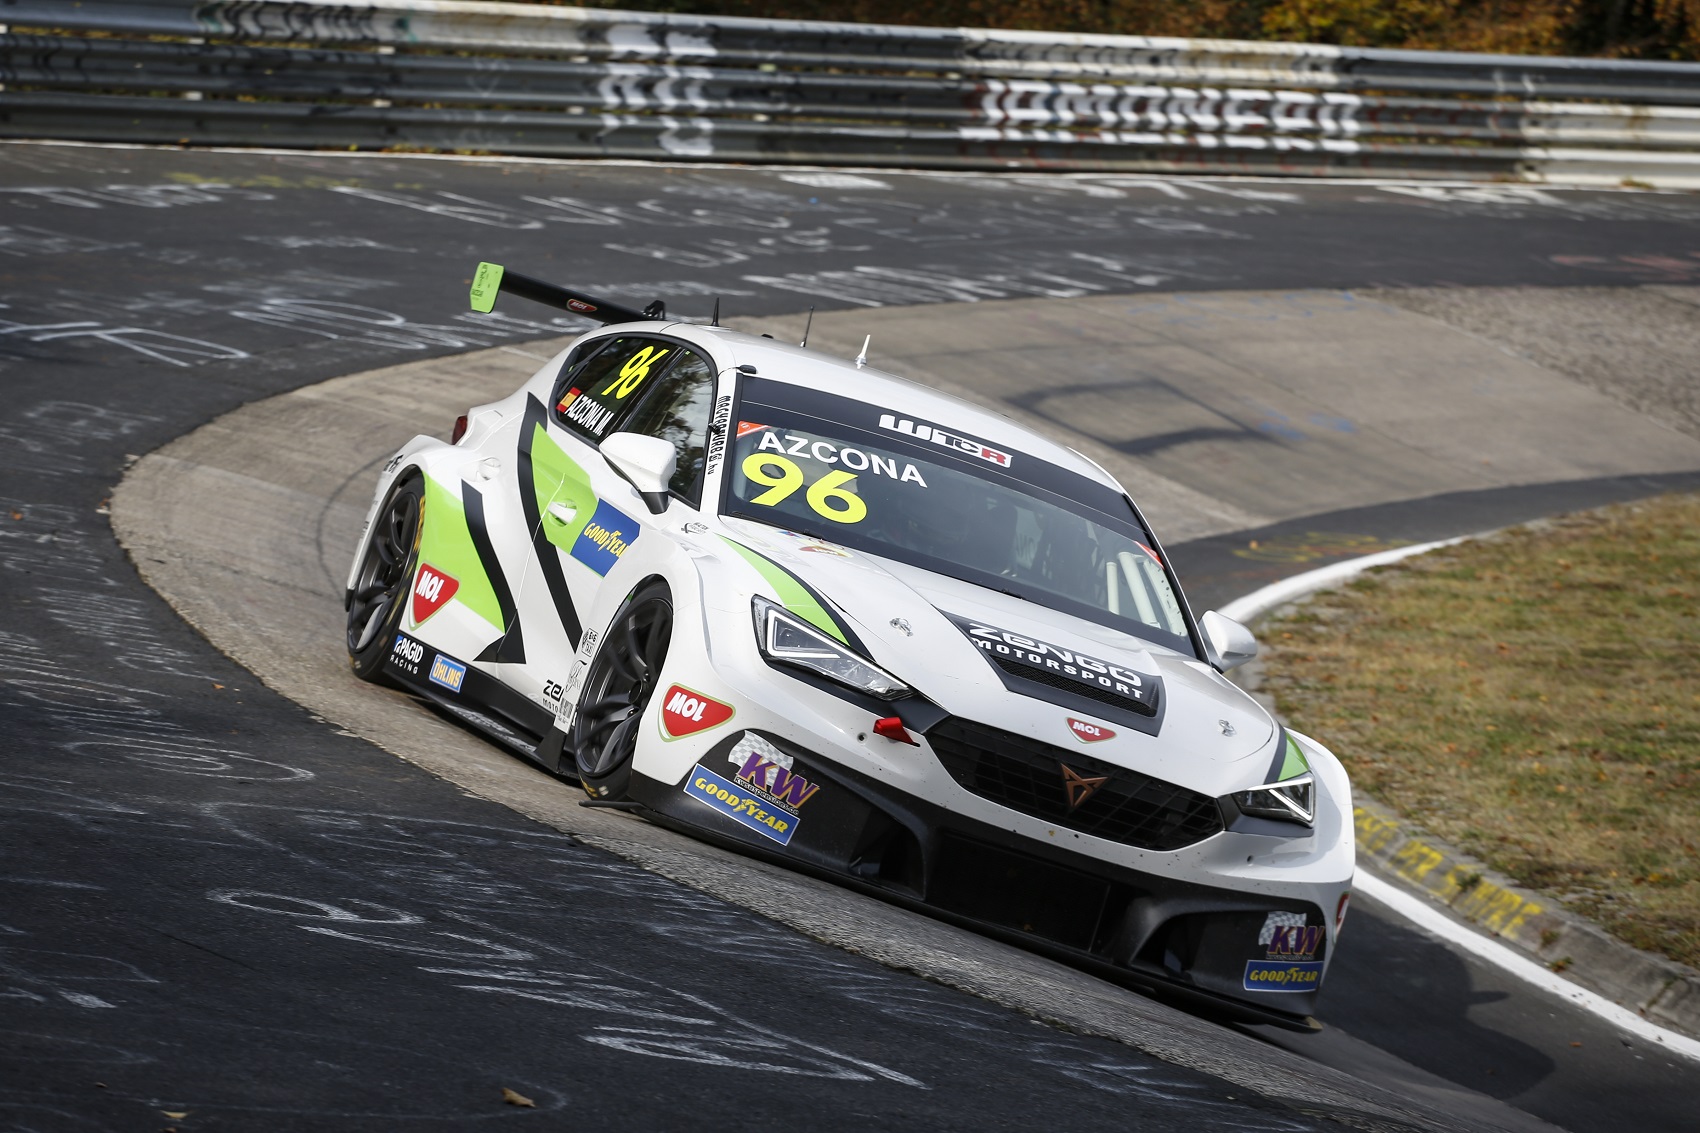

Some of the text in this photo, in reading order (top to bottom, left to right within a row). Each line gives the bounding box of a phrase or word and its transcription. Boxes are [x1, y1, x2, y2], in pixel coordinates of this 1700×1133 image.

[570, 301, 588, 310] MOL
[601, 346, 670, 399] 96
[564, 394, 606, 431] AZCONA
[758, 431, 928, 488] AZCONA
[878, 414, 1014, 469] WTCR
[741, 452, 868, 524] 96
[583, 522, 629, 558] GOODYEA
[415, 570, 445, 603] MOL
[389, 654, 419, 675] RACING
[400, 637, 424, 664] PAGID
[968, 622, 1142, 687] ZENGO
[971, 637, 1144, 699] MOTORSPORT
[433, 658, 464, 688] ÖHLINS
[665, 691, 707, 722] MOL
[1072, 721, 1102, 737] MOL
[736, 751, 821, 810] KW
[694, 777, 789, 834] GOODYEAR
[1266, 924, 1326, 955] KW
[1249, 968, 1319, 984] GOODYEAR
